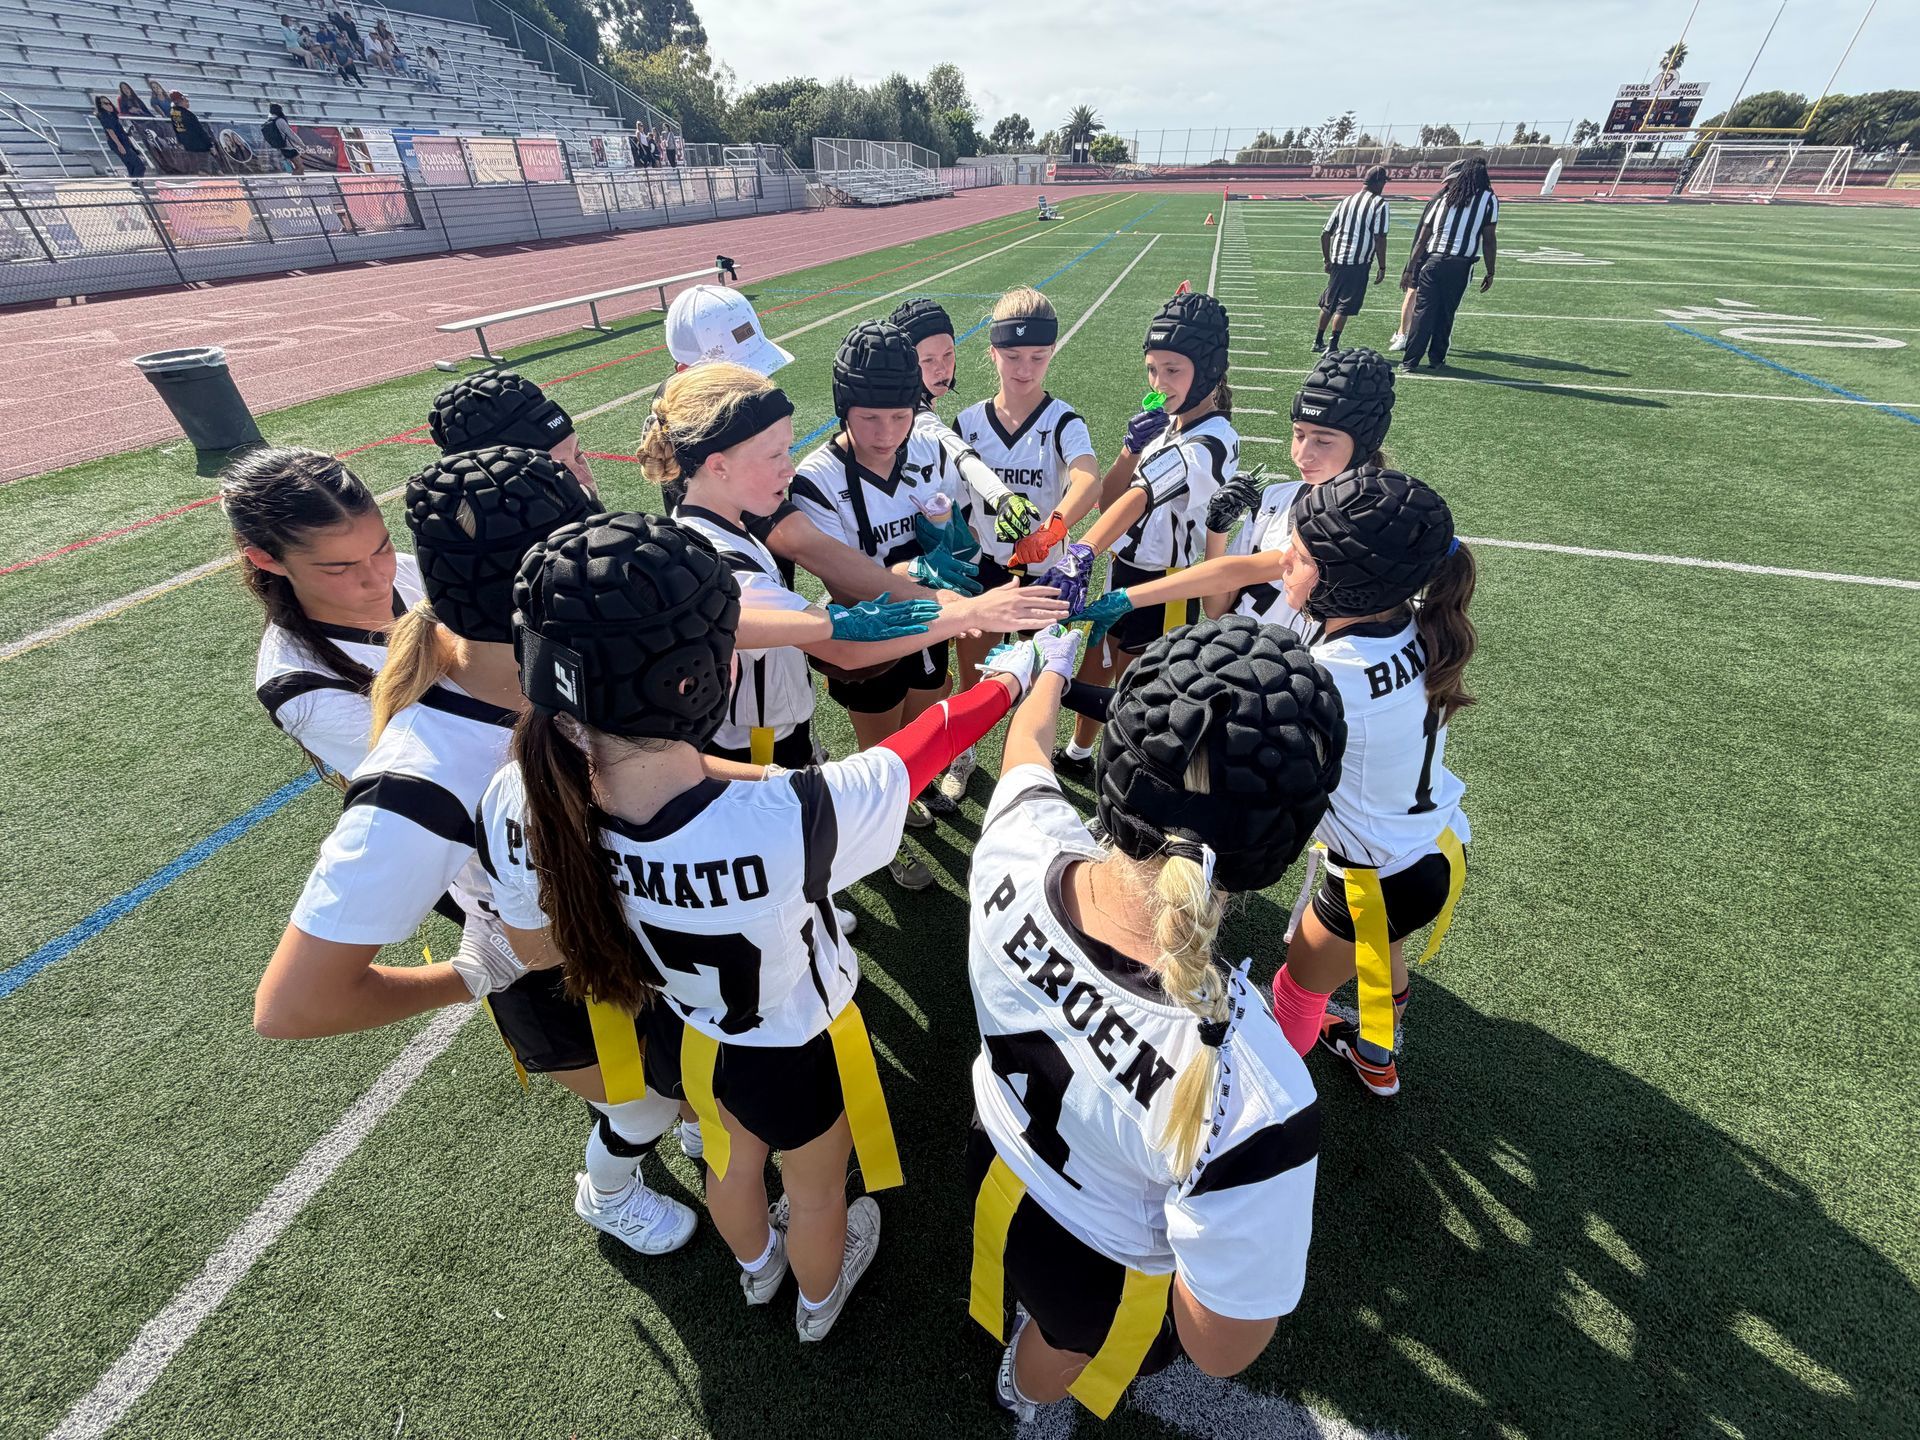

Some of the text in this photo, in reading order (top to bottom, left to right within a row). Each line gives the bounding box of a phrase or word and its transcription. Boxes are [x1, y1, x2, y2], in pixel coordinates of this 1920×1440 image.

[546, 415, 564, 429] TUOY
[1302, 407, 1322, 416] TUOY
[990, 467, 1043, 488] ERICKS
[857, 512, 923, 550] AVERI
[1001, 1345, 1012, 1388] NIKE
